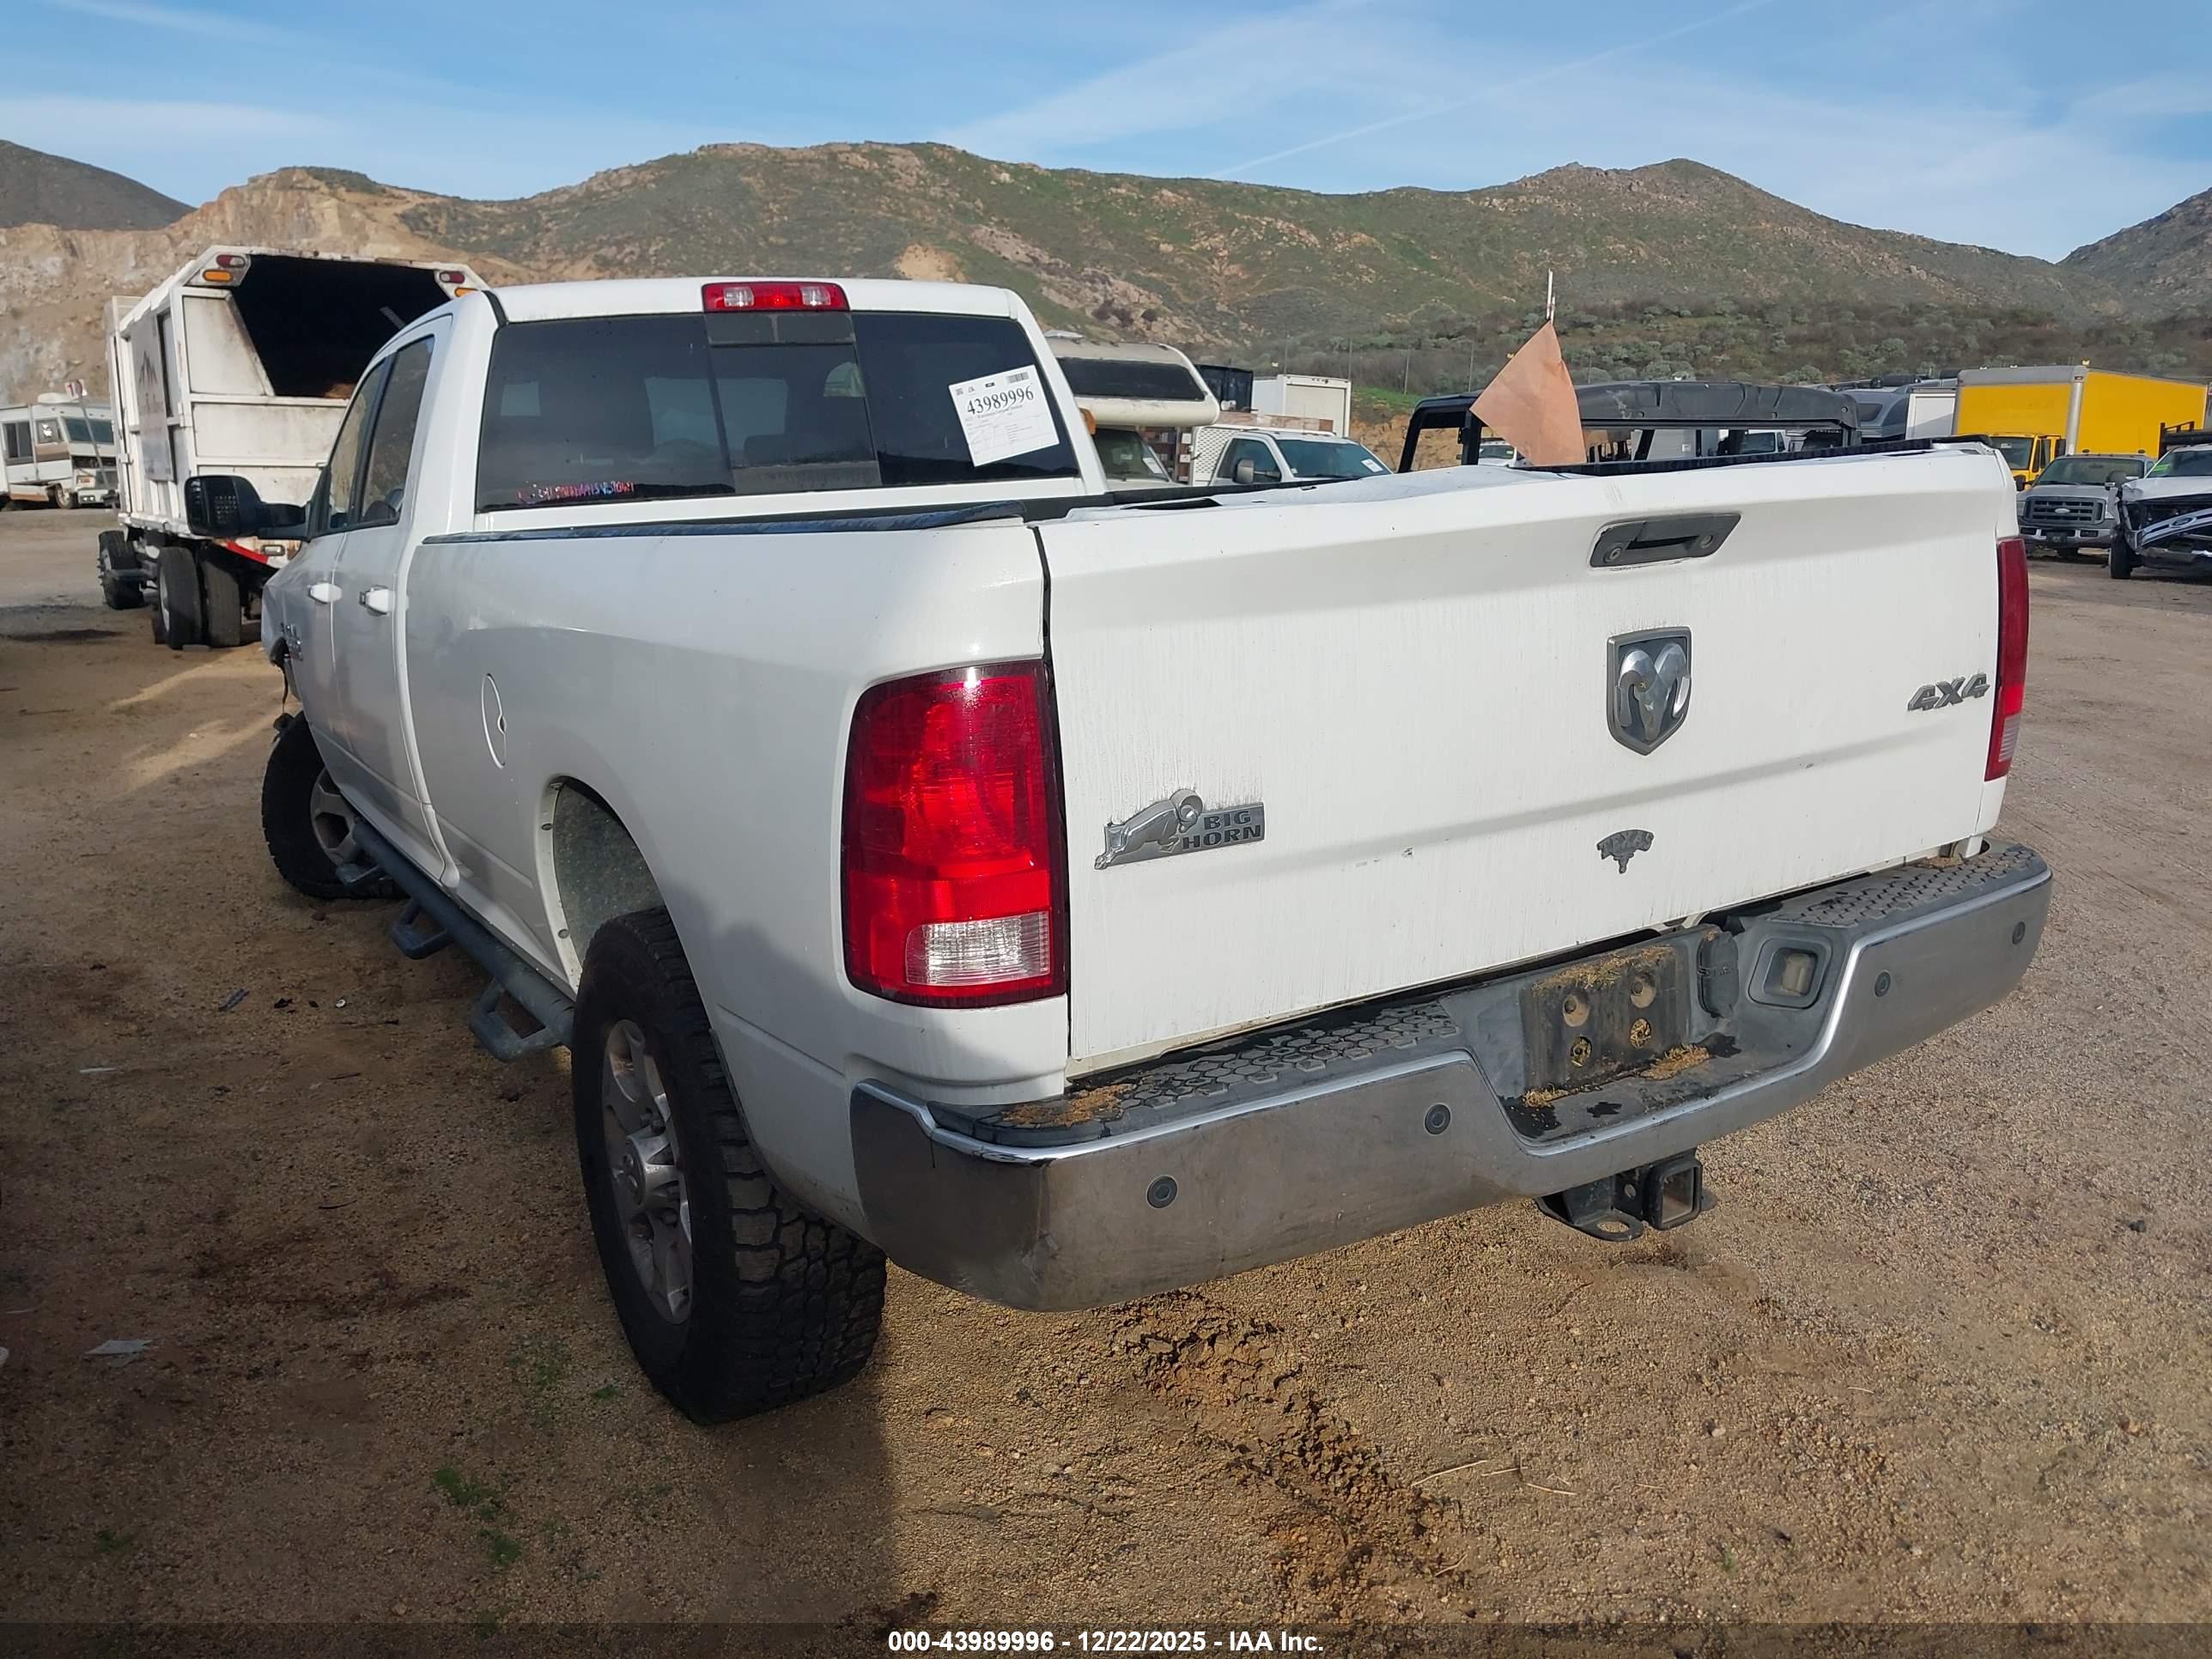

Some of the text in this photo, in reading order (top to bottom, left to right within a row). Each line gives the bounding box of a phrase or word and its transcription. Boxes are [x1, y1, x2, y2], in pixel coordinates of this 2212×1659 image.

[966, 385, 1035, 416] 43989996
[1907, 673, 1991, 712] 4X4
[1203, 809, 1252, 830] BIG
[1182, 823, 1261, 850] HORN
